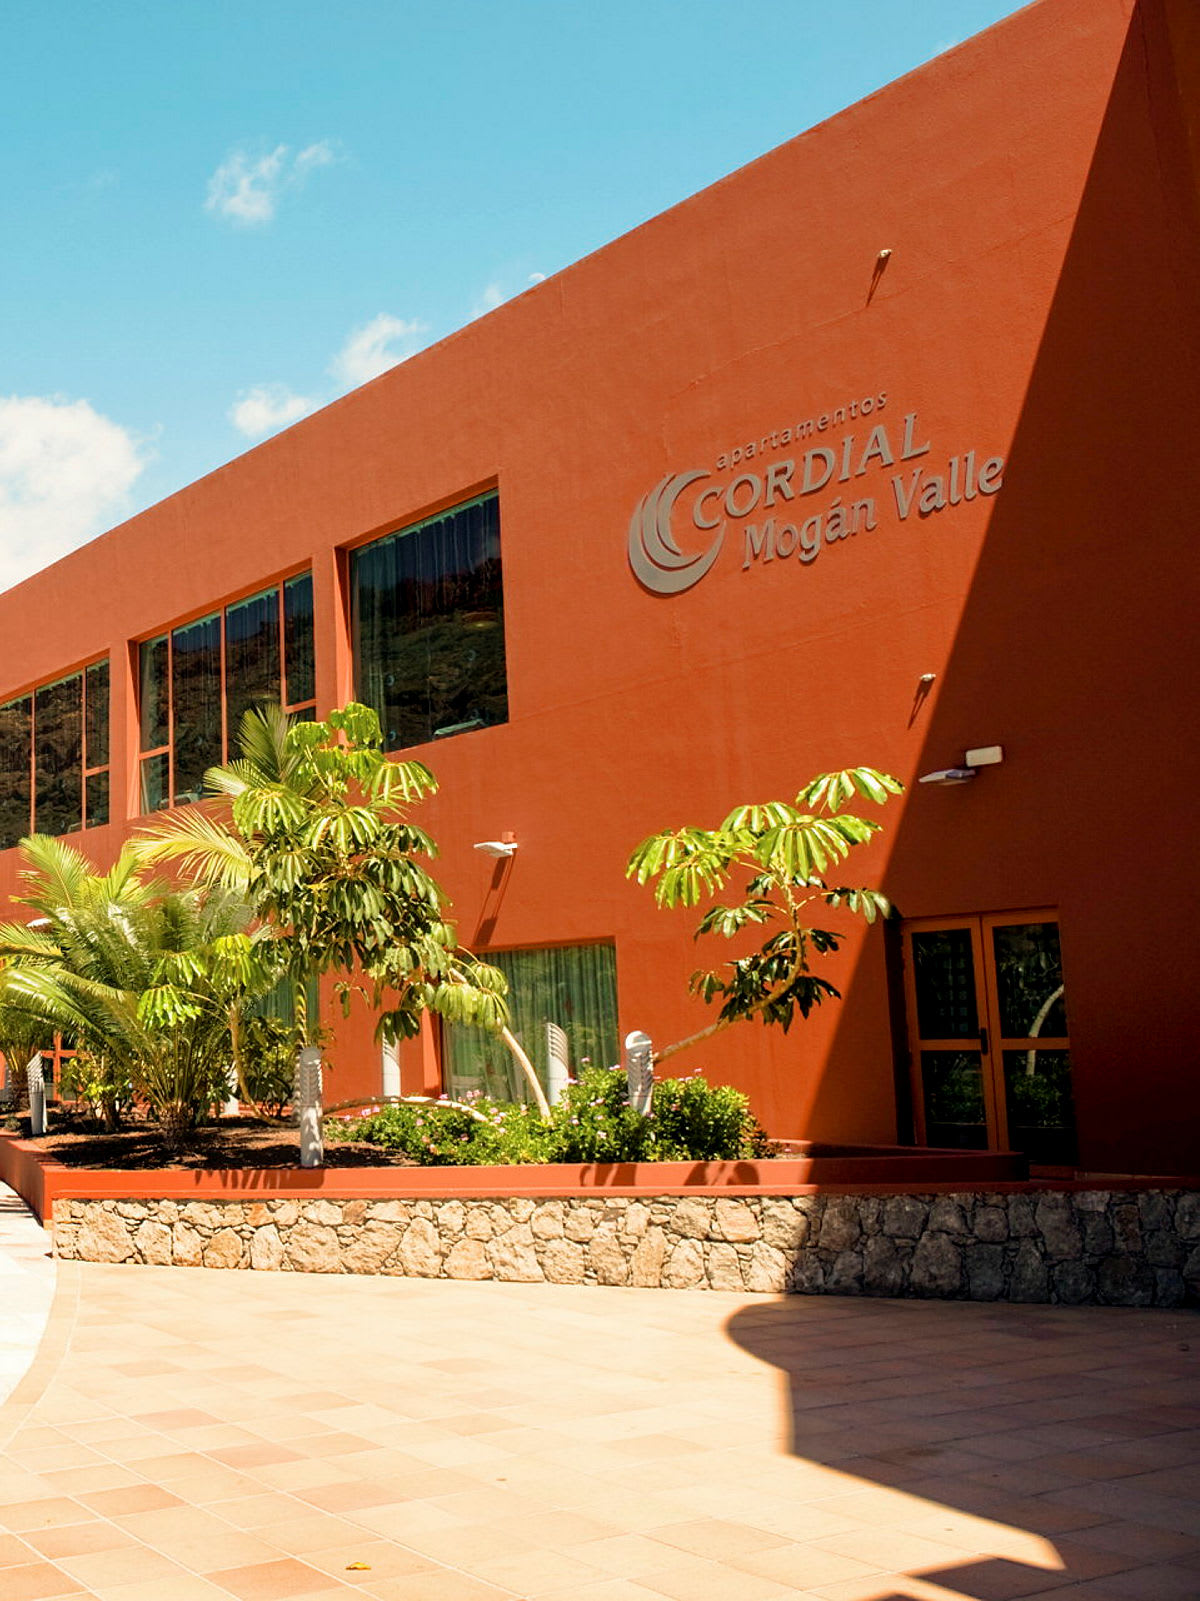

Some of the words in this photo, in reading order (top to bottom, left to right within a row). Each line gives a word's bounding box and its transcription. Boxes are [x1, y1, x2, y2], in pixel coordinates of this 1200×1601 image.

[693, 412, 931, 530] CORDIAL
[716, 390, 888, 470] apartamentos
[742, 496, 878, 570] Mogán
[891, 450, 1005, 521] Valle
